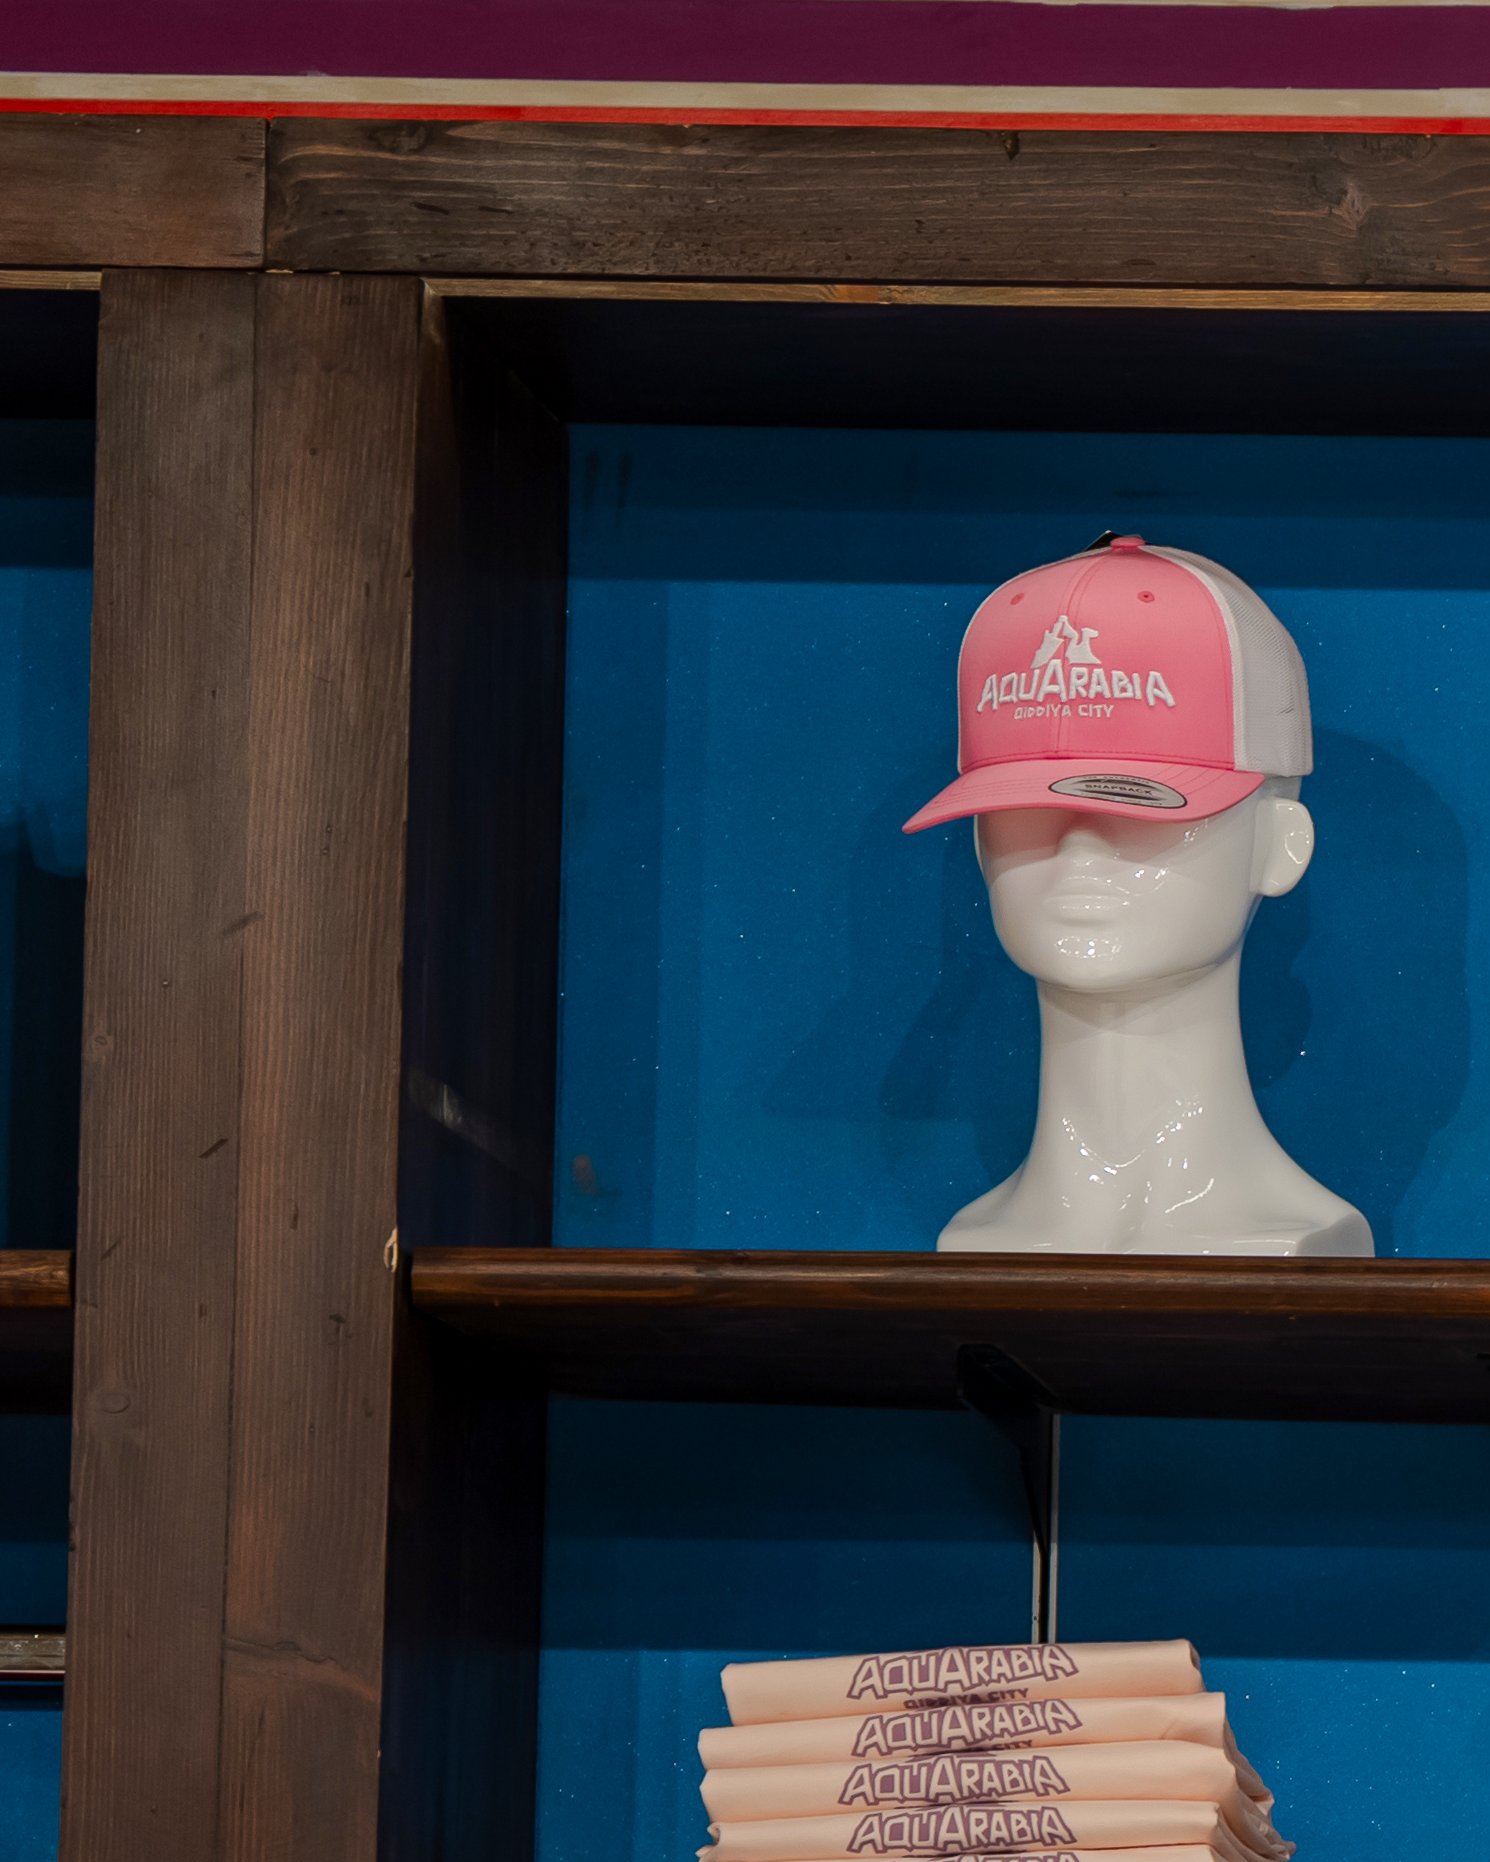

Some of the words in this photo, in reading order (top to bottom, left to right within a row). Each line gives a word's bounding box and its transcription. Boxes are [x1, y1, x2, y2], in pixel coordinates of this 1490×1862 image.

[976, 658, 1176, 712] AQUARABIA
[1014, 704, 1072, 719] QIDDIYA
[1078, 704, 1114, 717] CITY
[847, 1644, 1079, 1700] AQUARABIA
[988, 1688, 1028, 1700] CITY
[851, 1699, 1083, 1757] AQUARABIA
[838, 1754, 1071, 1805] AQUARABIA
[846, 1806, 1078, 1853] AQUARABIA
